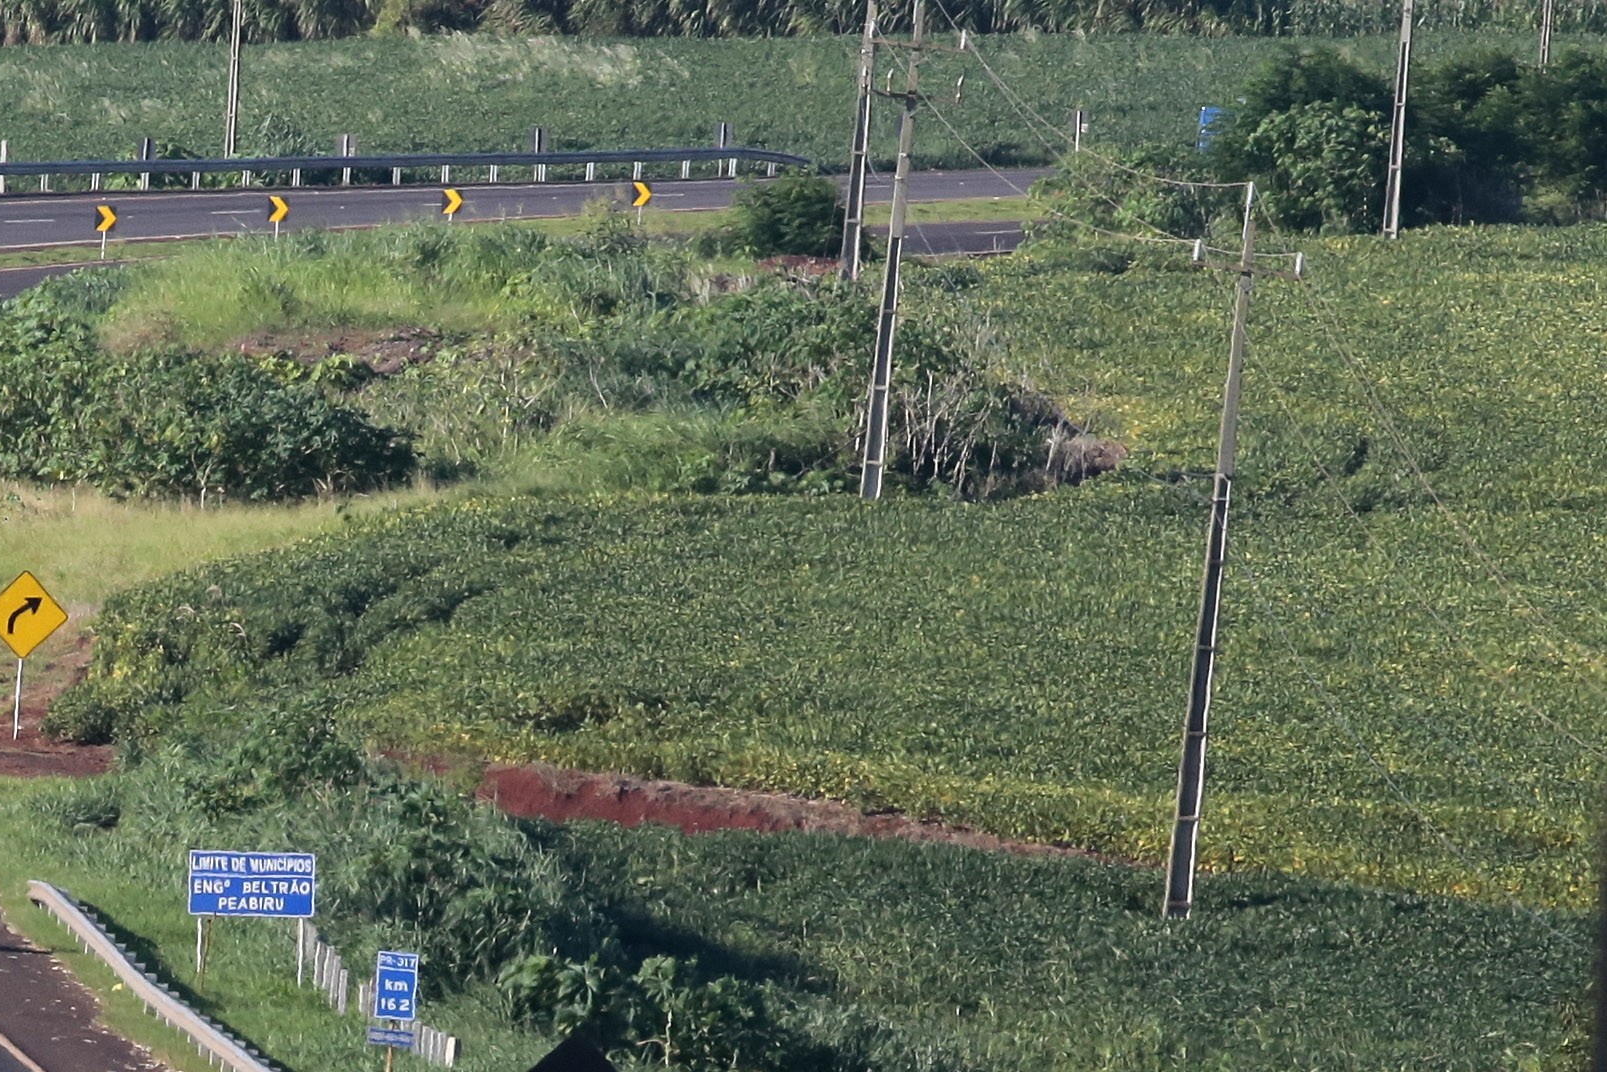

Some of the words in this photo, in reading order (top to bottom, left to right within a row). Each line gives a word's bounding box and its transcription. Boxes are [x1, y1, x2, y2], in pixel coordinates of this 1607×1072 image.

[192, 856, 228, 871] LIMITE
[231, 857, 246, 872] DE
[243, 879, 310, 895] BELTRÃO
[218, 897, 284, 911] PEABIRU
[380, 955, 416, 968] PR-317
[384, 979, 408, 992] km
